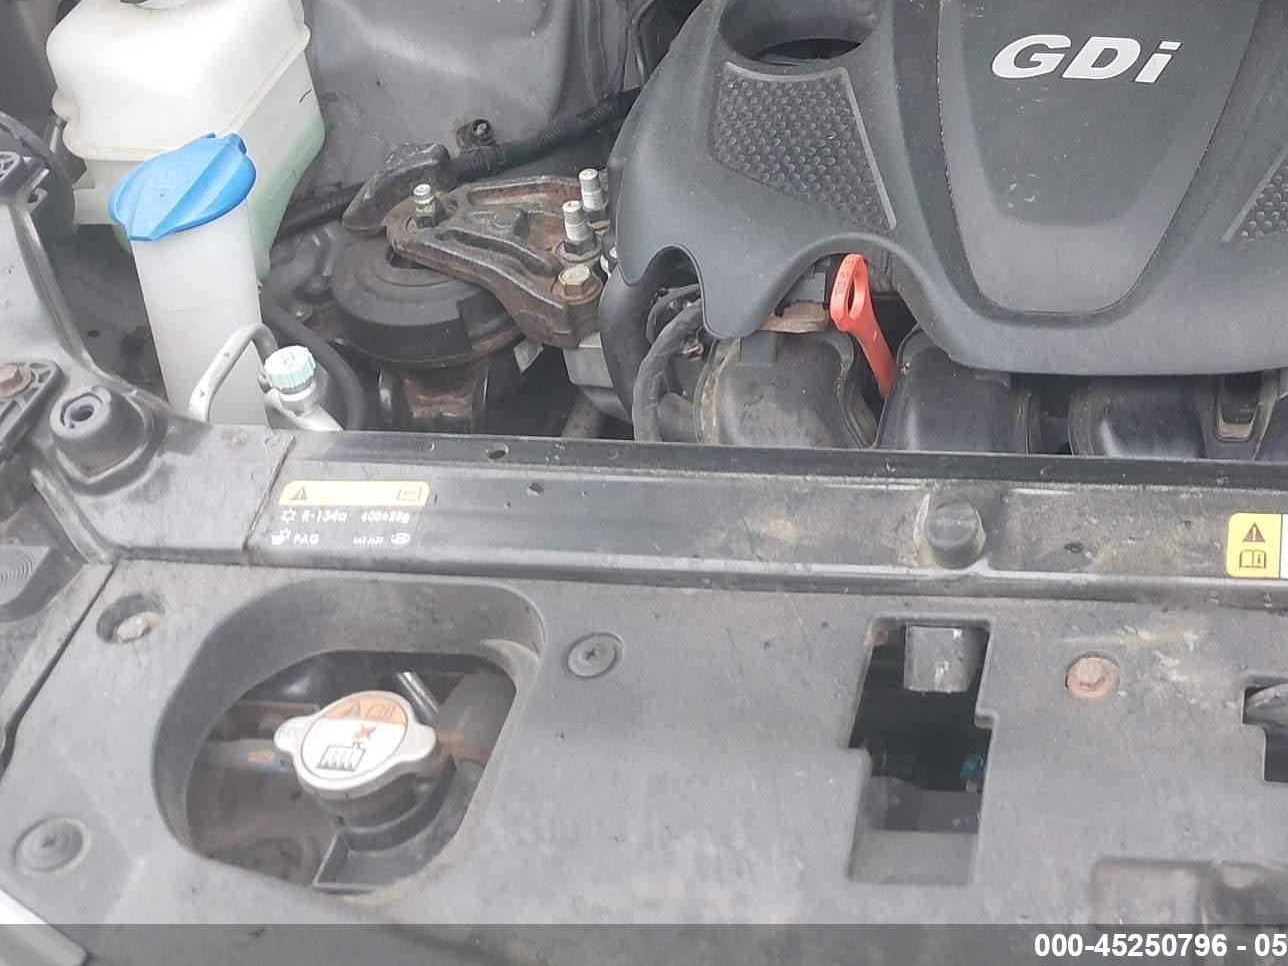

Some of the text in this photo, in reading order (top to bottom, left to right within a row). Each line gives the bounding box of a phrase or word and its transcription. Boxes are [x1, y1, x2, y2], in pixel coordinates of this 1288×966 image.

[992, 34, 1182, 83] GDi
[301, 509, 347, 523] R-134a
[293, 533, 320, 546] PAG
